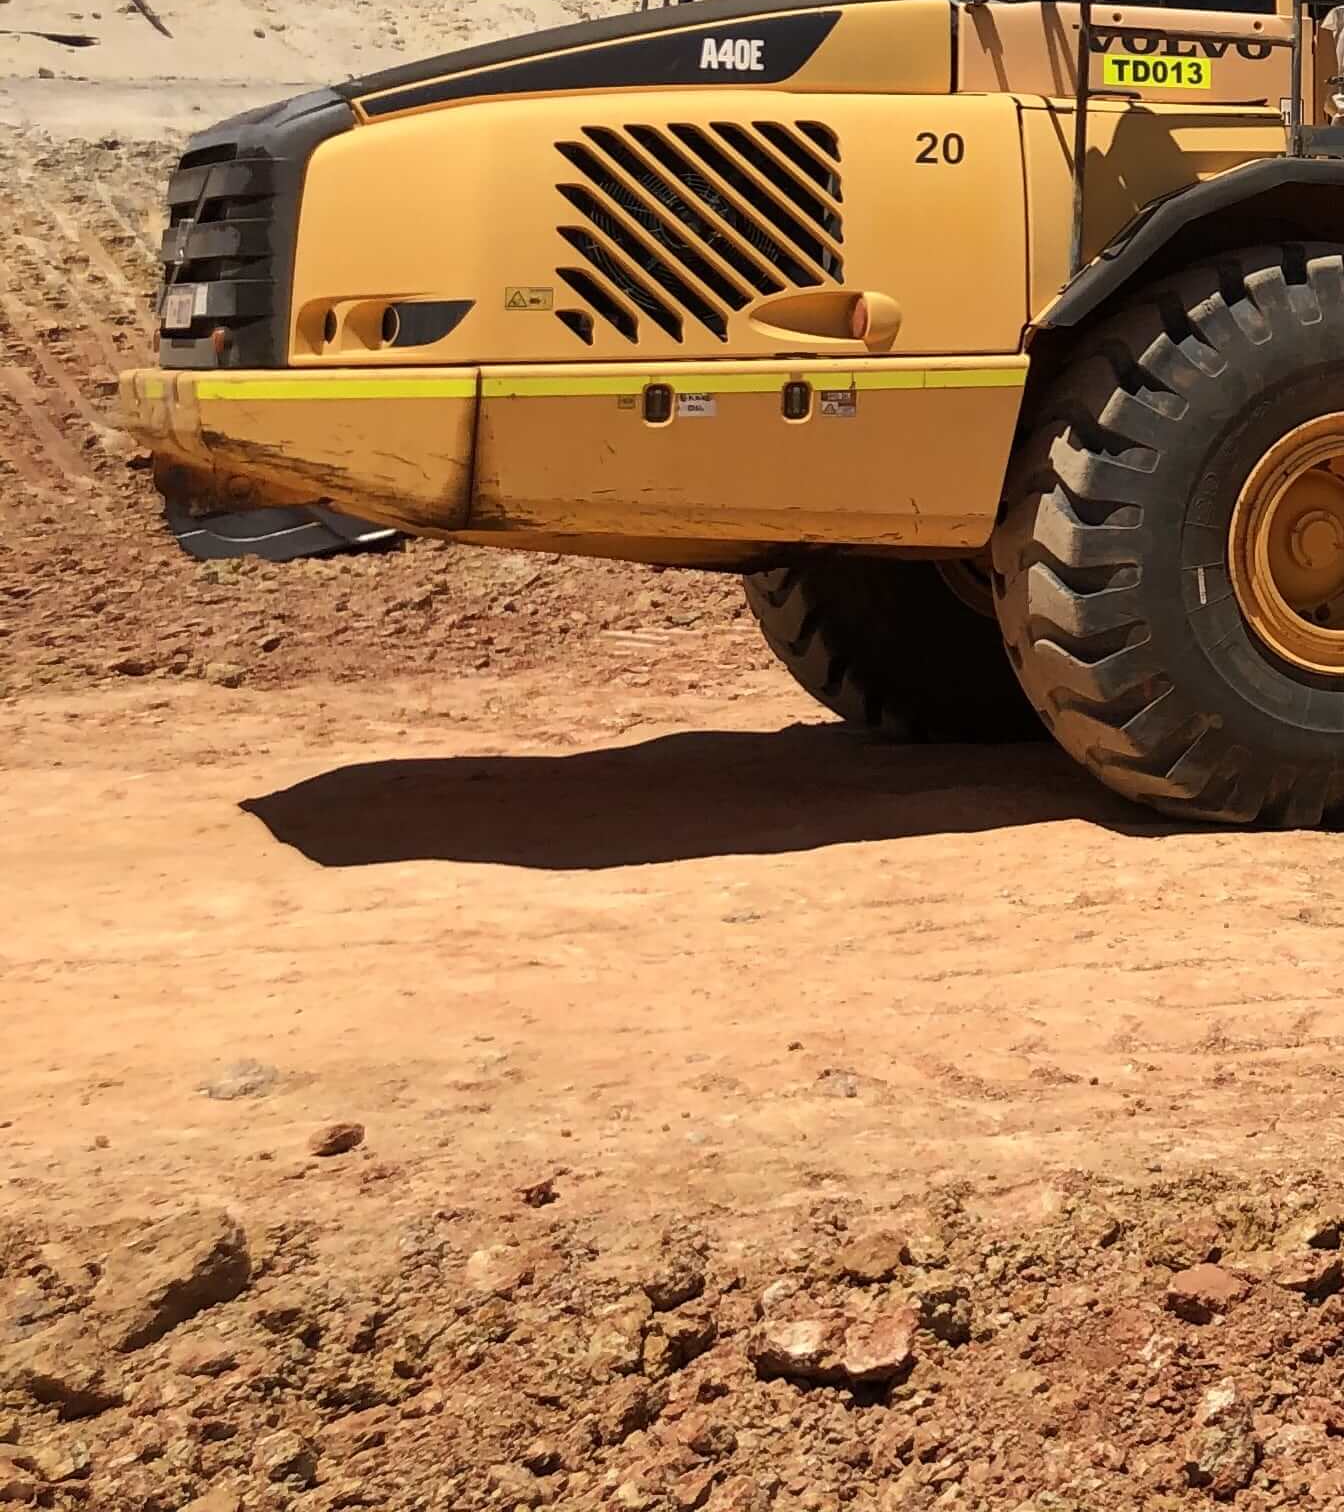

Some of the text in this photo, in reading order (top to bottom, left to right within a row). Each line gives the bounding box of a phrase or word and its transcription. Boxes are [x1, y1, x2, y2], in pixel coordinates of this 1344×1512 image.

[699, 37, 765, 71] A40E
[1087, 33, 1273, 60] VOLVO
[1111, 58, 1204, 85] TD013
[914, 131, 965, 165] 20
